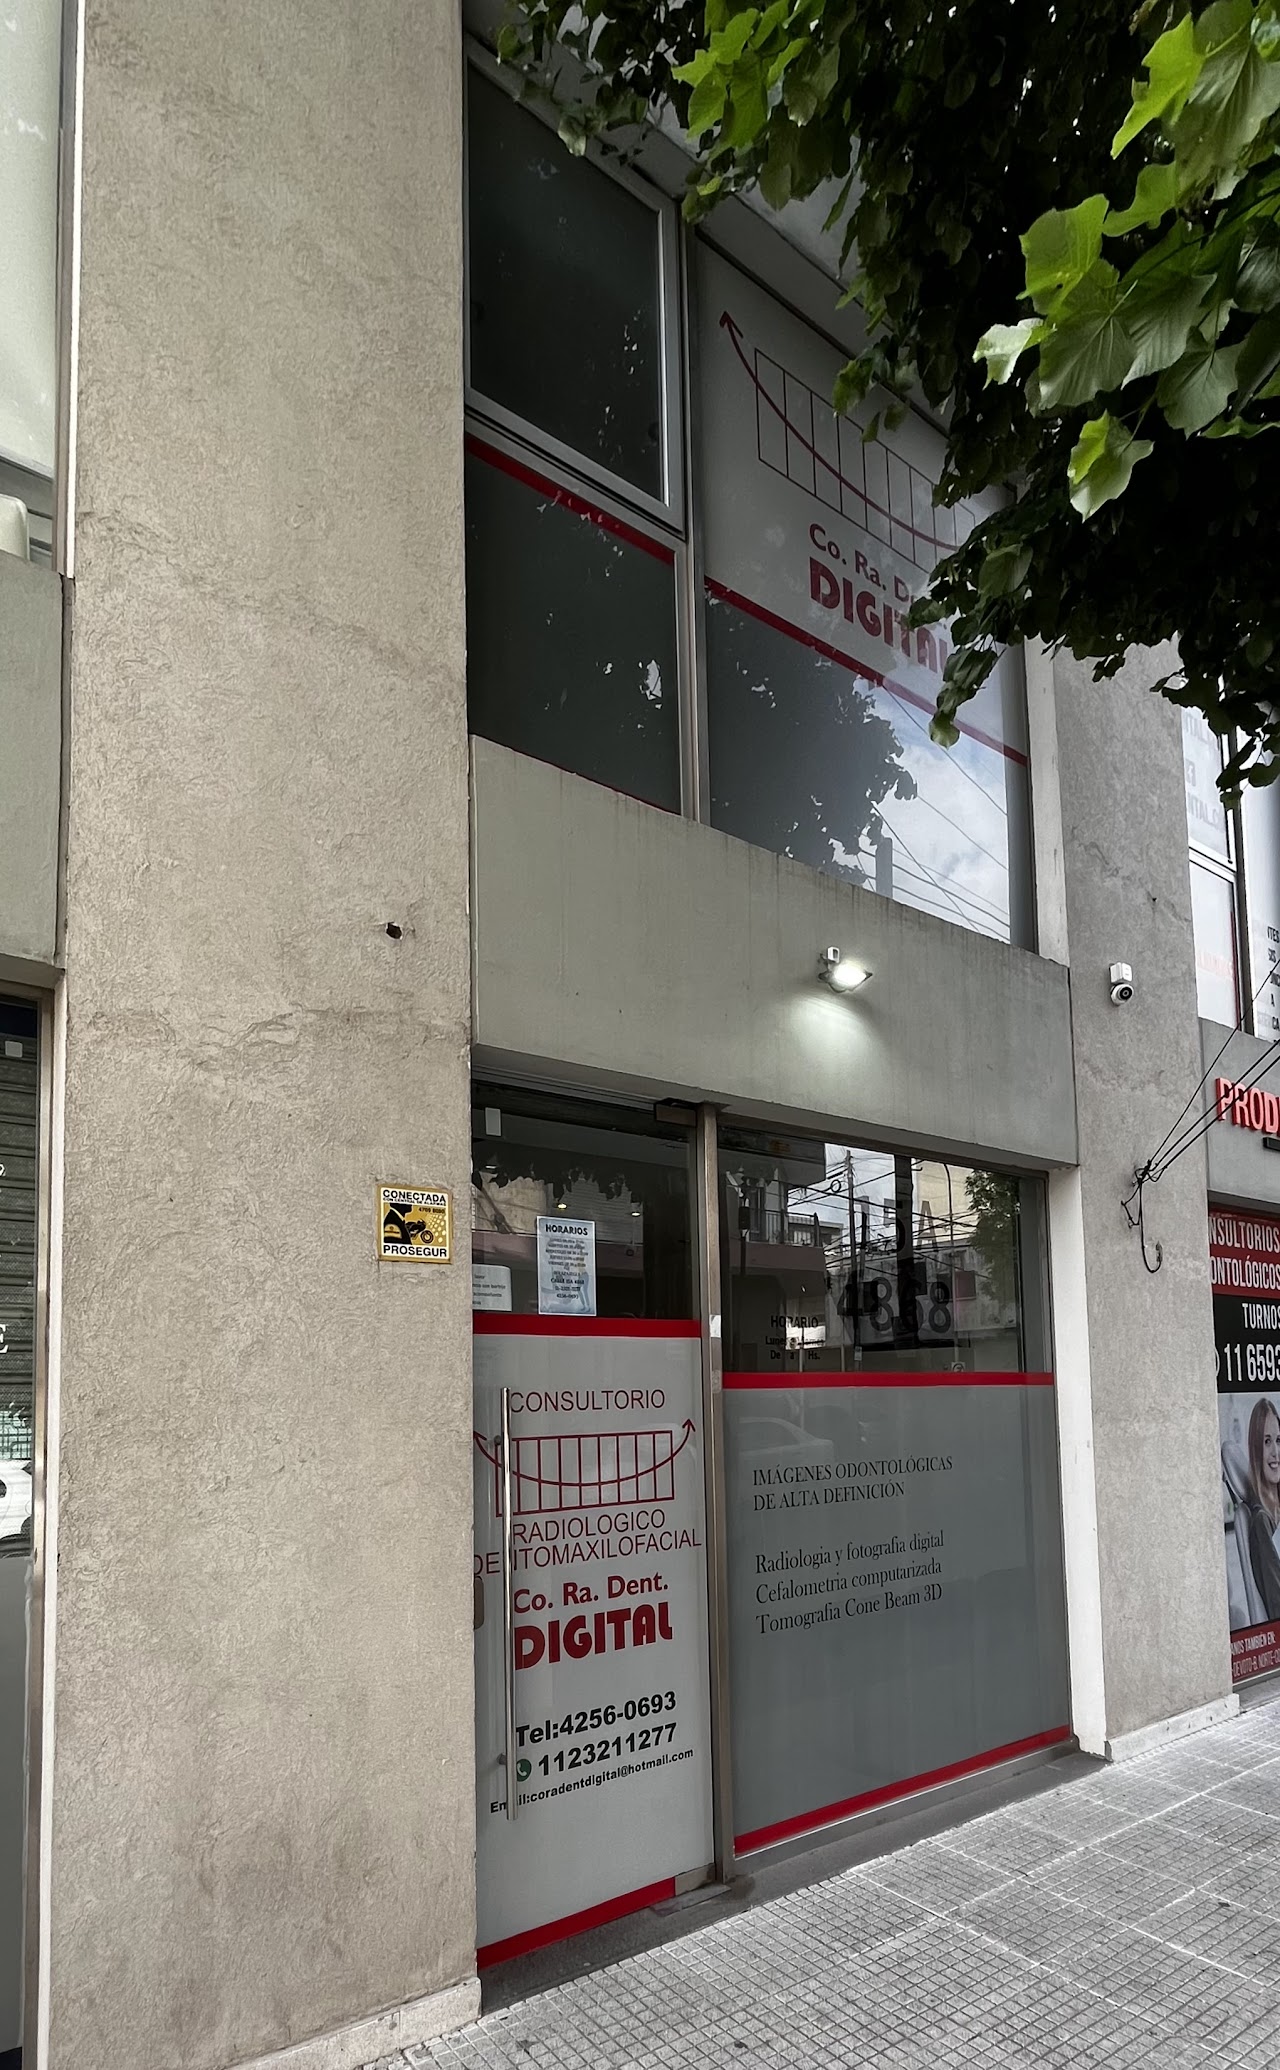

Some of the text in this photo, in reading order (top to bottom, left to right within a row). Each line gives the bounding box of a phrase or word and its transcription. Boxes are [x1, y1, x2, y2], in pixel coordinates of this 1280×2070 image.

[810, 523, 846, 565] Co.
[855, 550, 887, 591] Ra.
[383, 1189, 447, 1203] CONECTADA
[545, 1223, 588, 1236] HORARIOS
[383, 1245, 447, 1257] PROSEGUR
[770, 1315, 819, 1328] HORARIO
[770, 1349, 782, 1360] De
[807, 1351, 821, 1360] Hs.
[1224, 1343, 1242, 1382] 11
[510, 1389, 666, 1412] CONSULTORIO
[753, 1455, 953, 1486] IMÁGENES ODONTOLÓGICAS
[753, 1481, 906, 1511] DE ALTA DEFINICIÓN
[513, 1509, 666, 1545] RADIOLOGICO
[835, 1549, 843, 1567] y
[909, 1530, 945, 1551] digital
[851, 1557, 942, 1588] computarizada
[514, 1572, 669, 1613] Co. Ra. Dent.
[845, 1596, 881, 1617] Cone
[884, 1590, 921, 1610] Beam
[923, 1583, 943, 1602] 3D
[514, 1602, 673, 1670] DIGITAL
[515, 1691, 676, 1747] Tel:4256-0693
[538, 1722, 677, 1776] 1123211277
[490, 1749, 694, 1813] Emil:coradentdigital@hotmail.com
